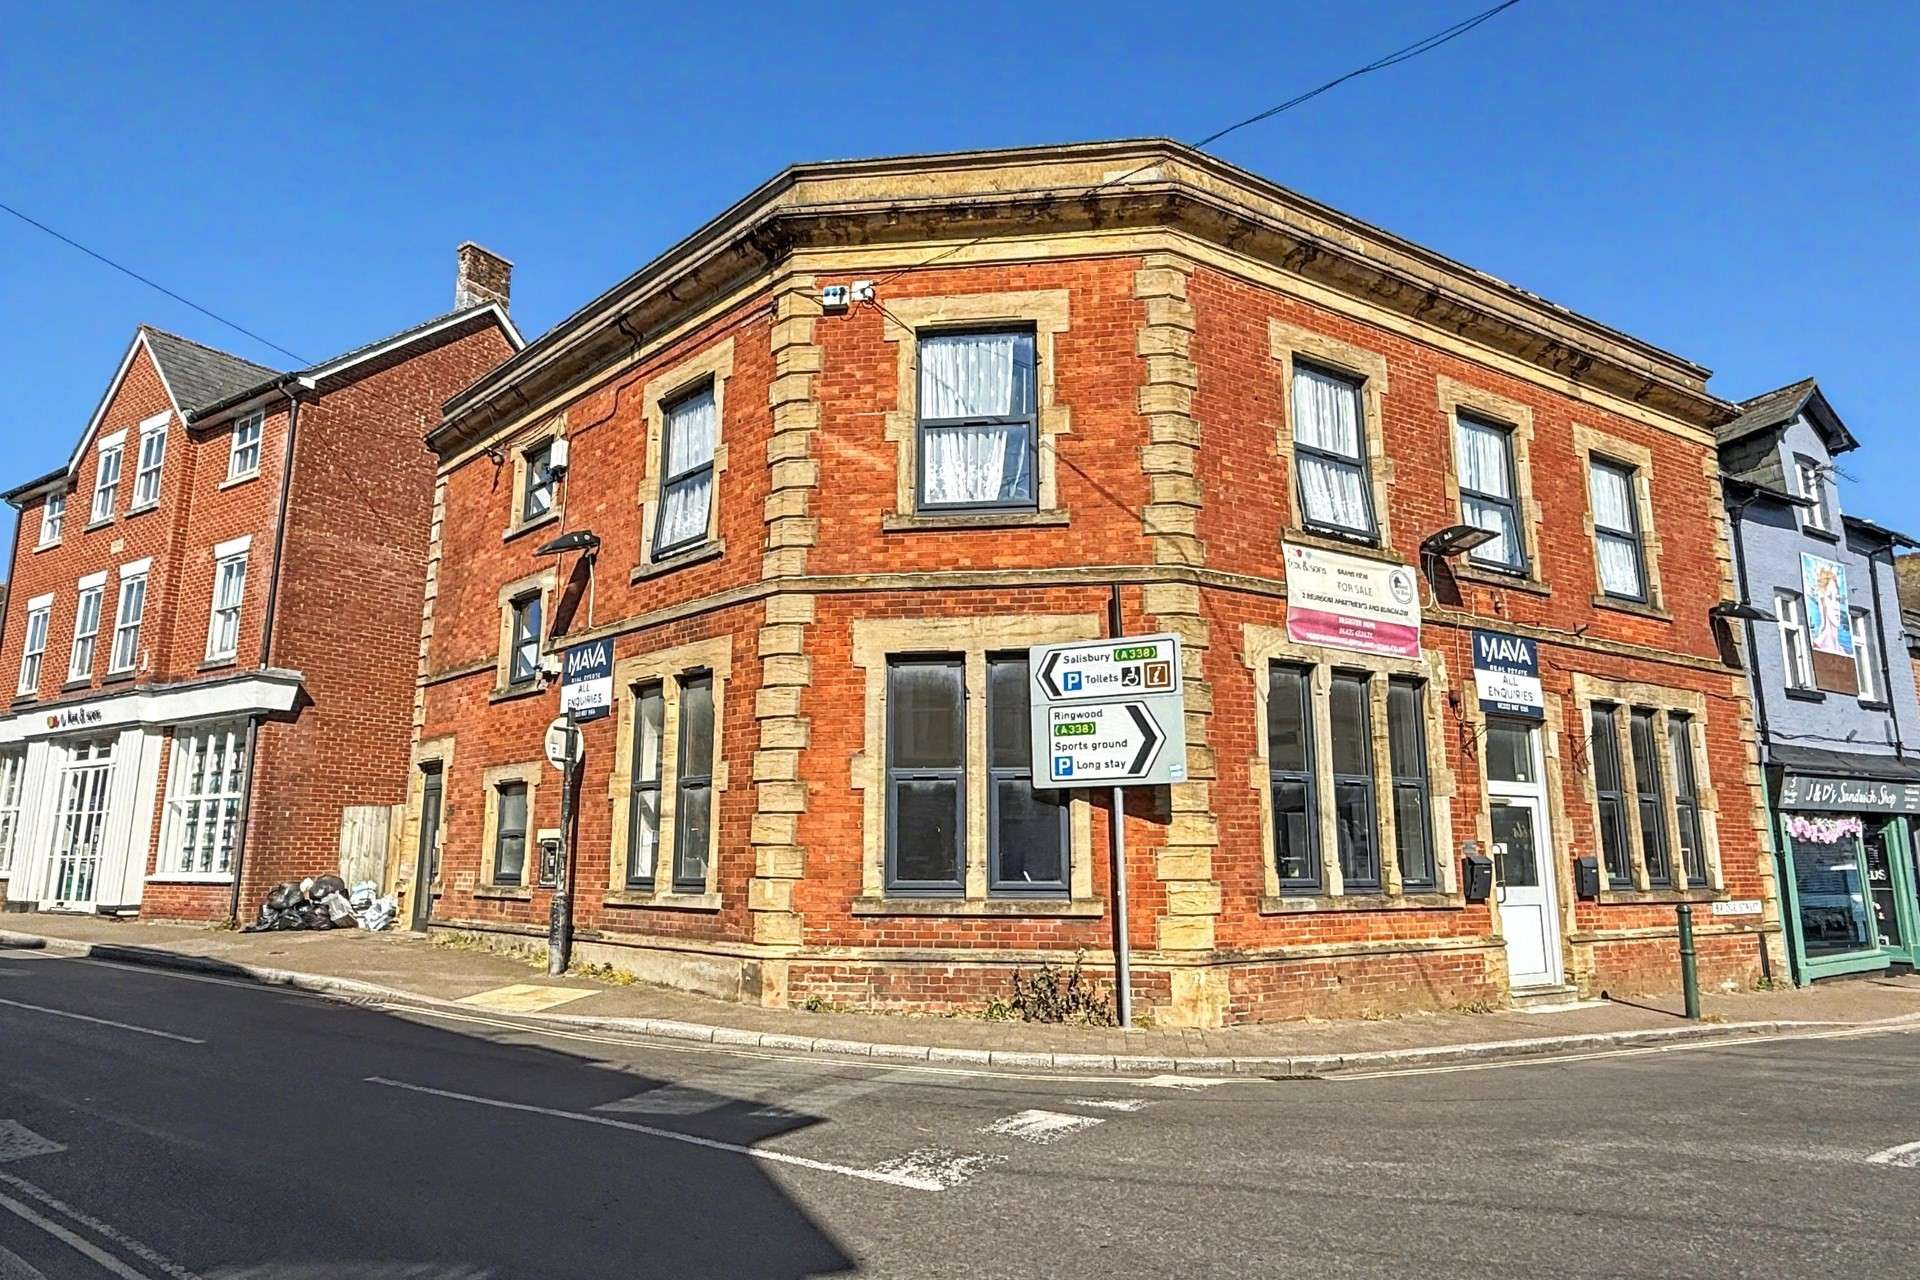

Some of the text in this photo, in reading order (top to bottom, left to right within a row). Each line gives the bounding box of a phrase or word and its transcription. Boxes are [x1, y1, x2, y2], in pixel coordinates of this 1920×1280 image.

[1355, 583, 1373, 597] SALE
[1063, 647, 1156, 665] Salisbury (A338)
[1480, 635, 1532, 665] MAVA
[568, 641, 607, 676] MAVA
[1085, 673, 1119, 684] Toilets
[1502, 674, 1518, 686] ALL
[577, 682, 590, 693] ALL
[1488, 686, 1534, 702] ENQUIRIES
[1054, 709, 1103, 721] Ringwood
[1054, 723, 1095, 736] (A338)
[1055, 739, 1128, 752] Sports ground
[1077, 760, 1101, 770] Long
[1104, 760, 1126, 770] stay
[1838, 782, 1877, 803] Sandwich
[1878, 784, 1897, 808] Shop
